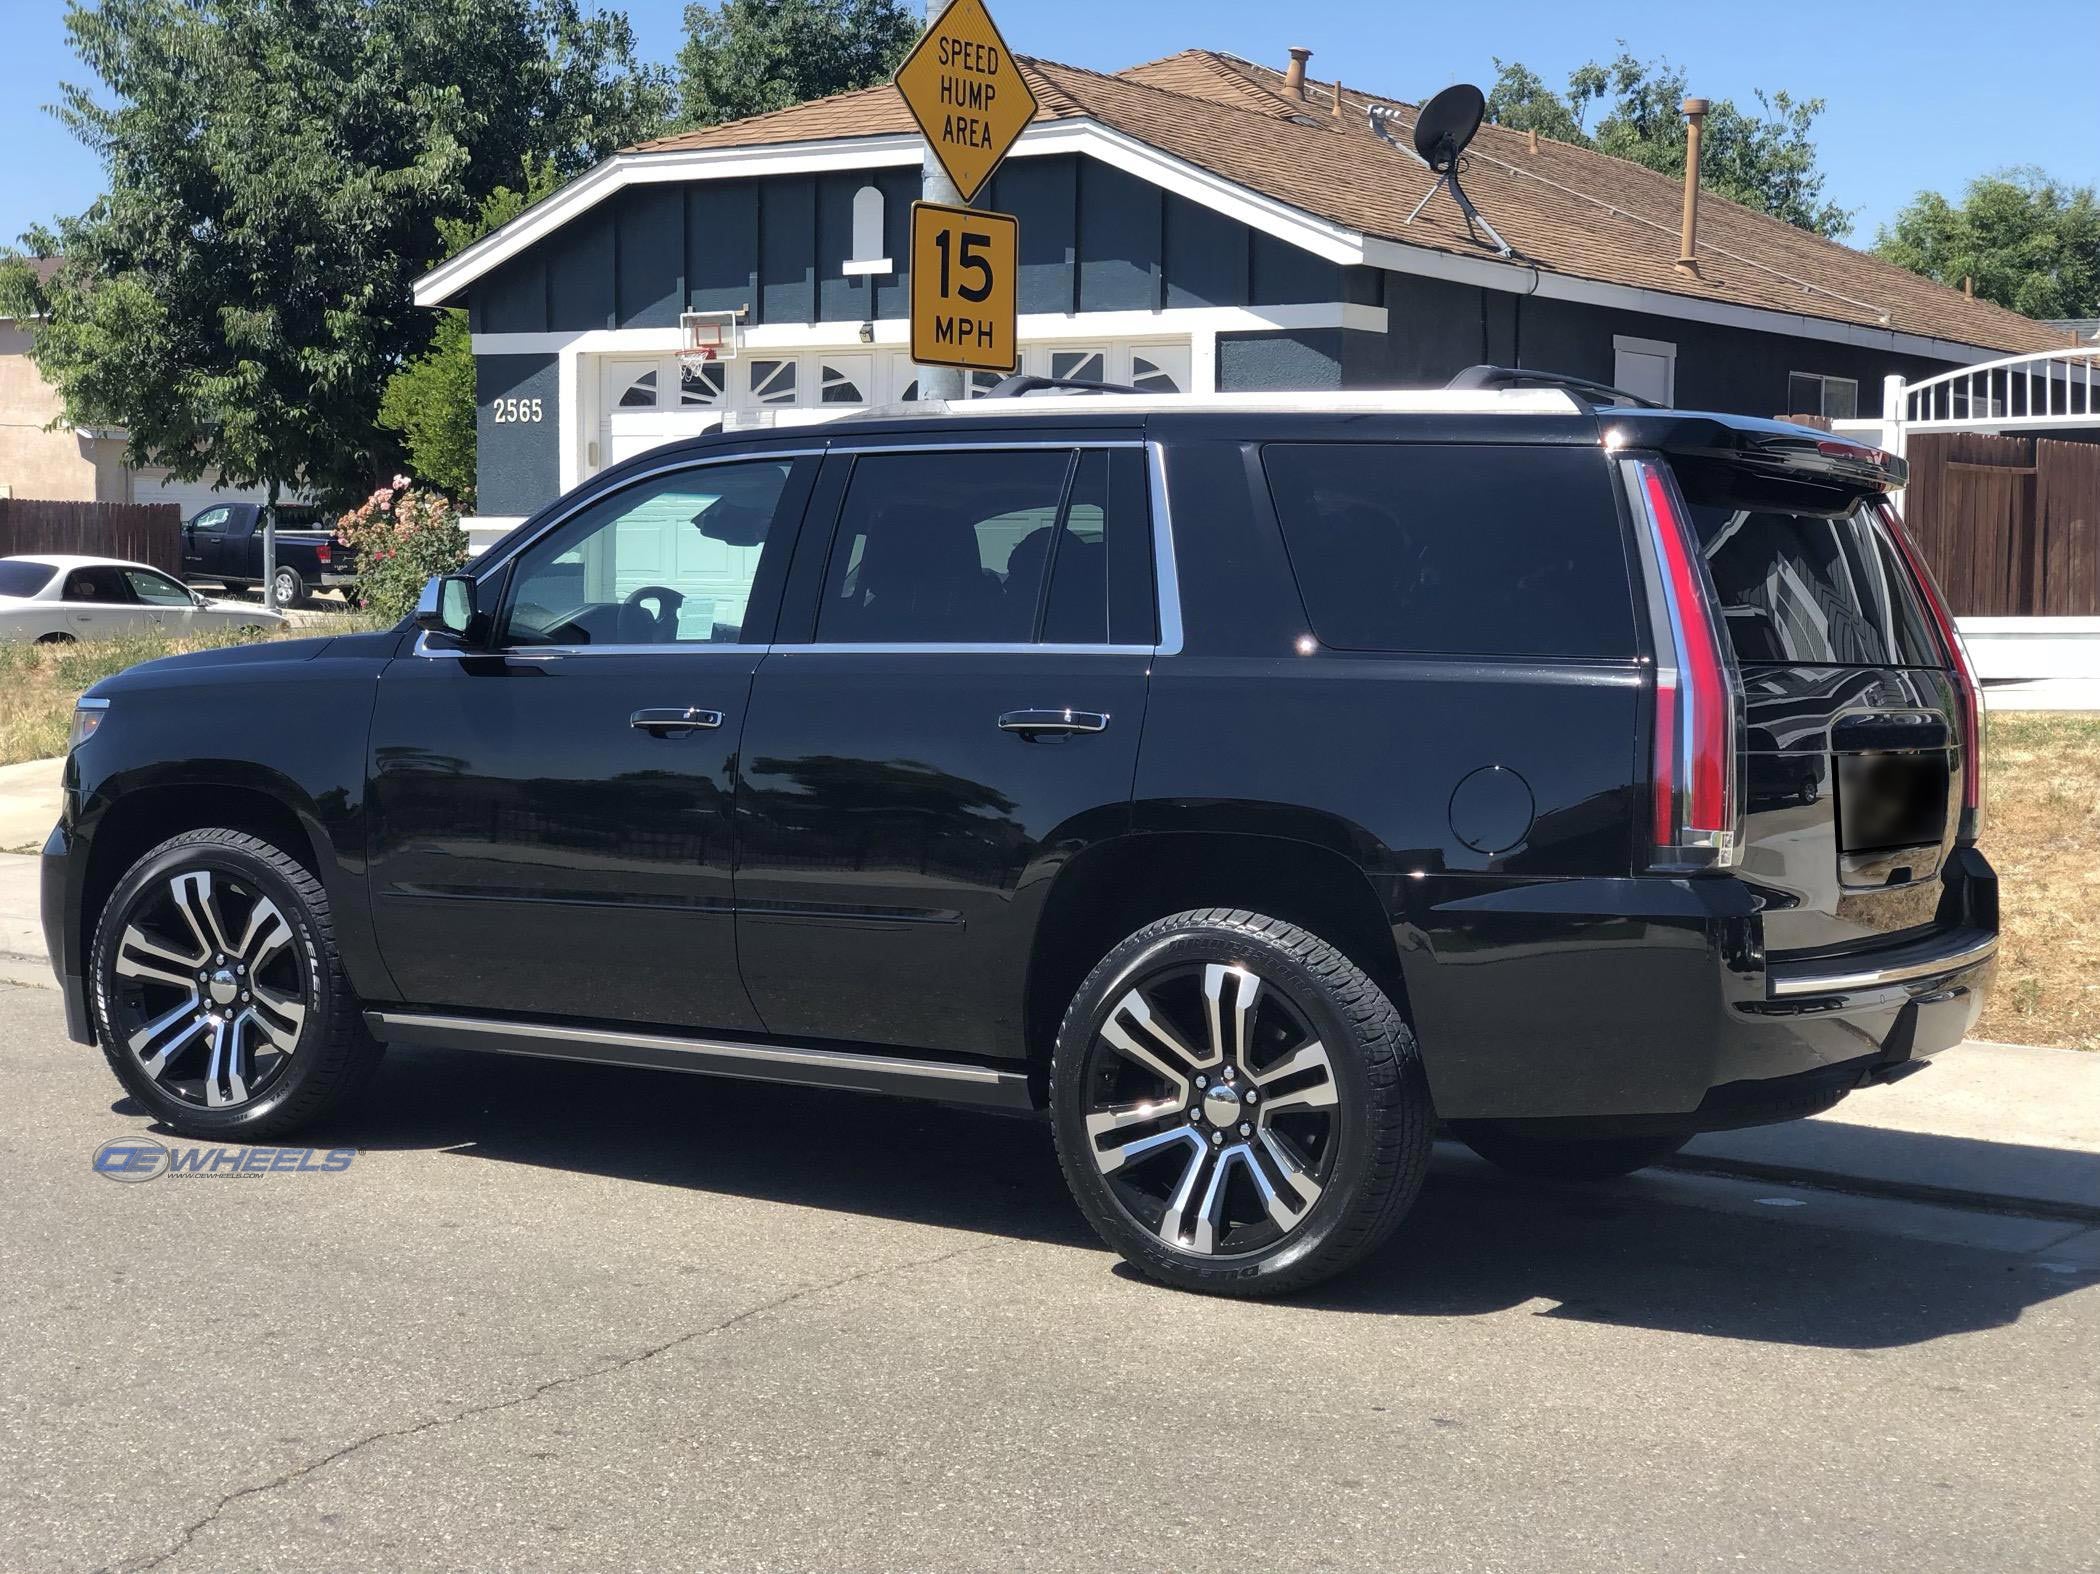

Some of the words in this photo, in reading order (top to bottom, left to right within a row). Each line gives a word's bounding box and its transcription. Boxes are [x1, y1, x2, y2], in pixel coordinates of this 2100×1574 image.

[938, 36, 999, 76] SPEED
[940, 75, 996, 112] HUMP
[942, 114, 993, 150] AREA
[935, 229, 994, 303] 15
[935, 315, 993, 349] MPH
[493, 398, 543, 423] 2565
